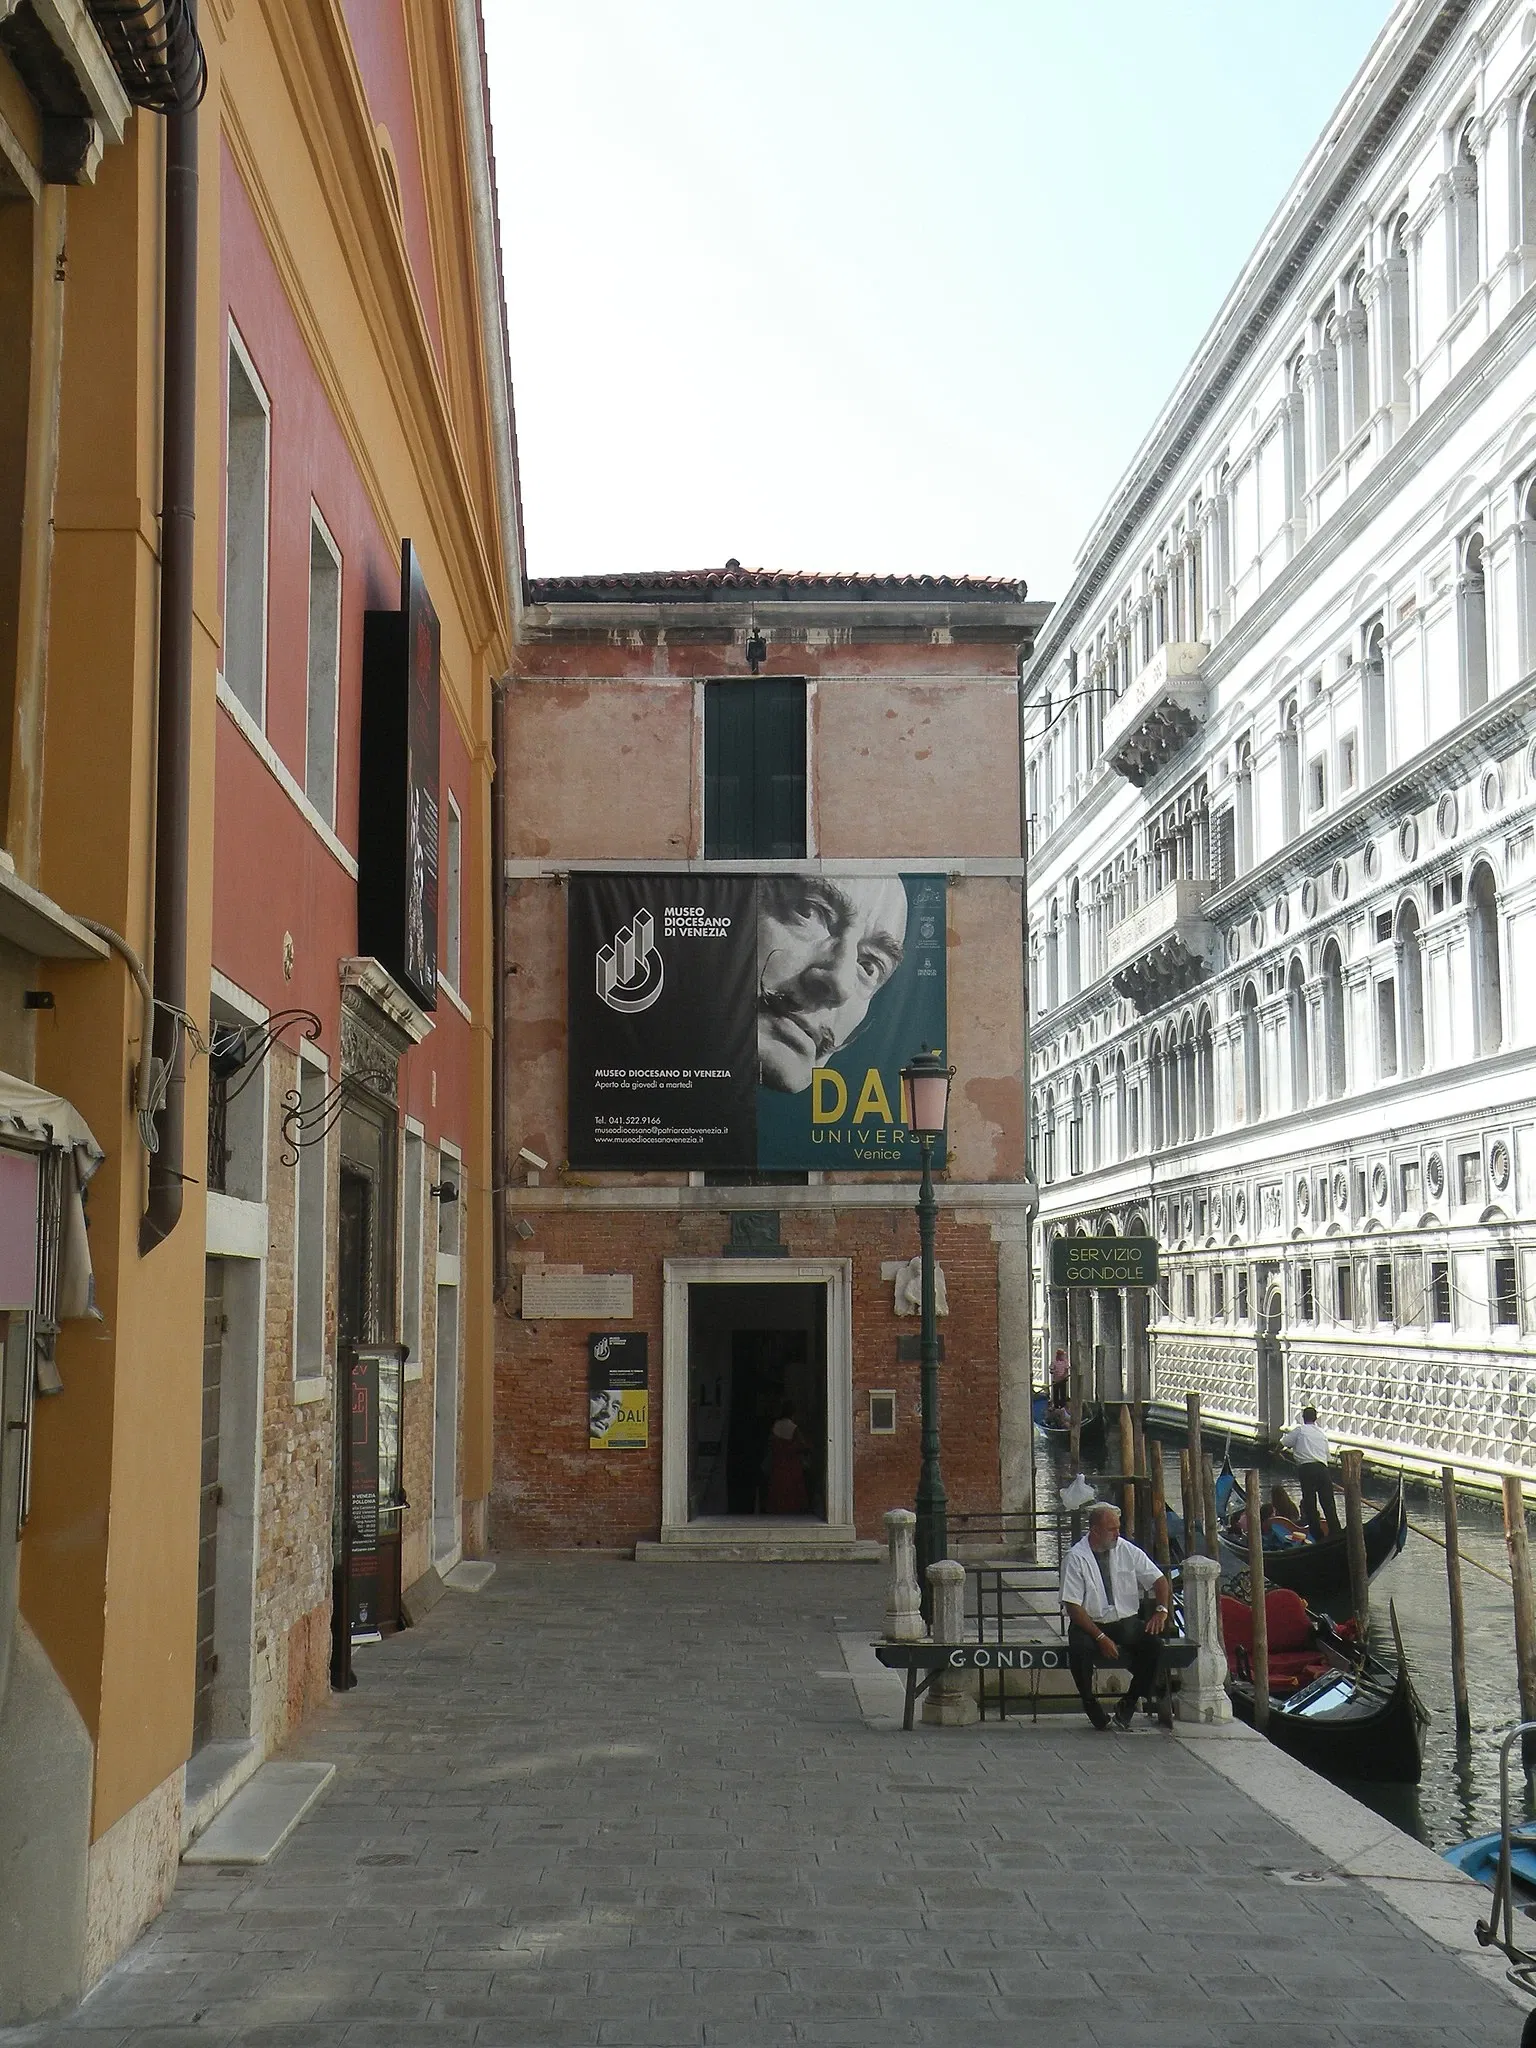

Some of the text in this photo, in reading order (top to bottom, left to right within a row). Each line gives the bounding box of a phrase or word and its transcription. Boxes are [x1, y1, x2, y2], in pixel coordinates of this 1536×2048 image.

[664, 907, 705, 917] MUSEO
[664, 917, 731, 927] DIOCESANO
[664, 927, 728, 937] DI VENEZIA
[595, 1069, 731, 1078] MUSEO DIOCESANO DI VENEZIA
[594, 1080, 620, 1089] Aperto
[620, 1080, 630, 1089] da
[594, 1116, 662, 1125] Tel. 041.522.9166
[594, 1136, 704, 1144] www.museodiocesanovenezia.it
[853, 1148, 901, 1160] Venice
[1069, 1248, 1142, 1261] SERVIZIO
[1066, 1266, 1144, 1280] GONDOLE
[616, 1406, 646, 1423] DALÍ
[949, 1649, 1070, 1669] GONDO
